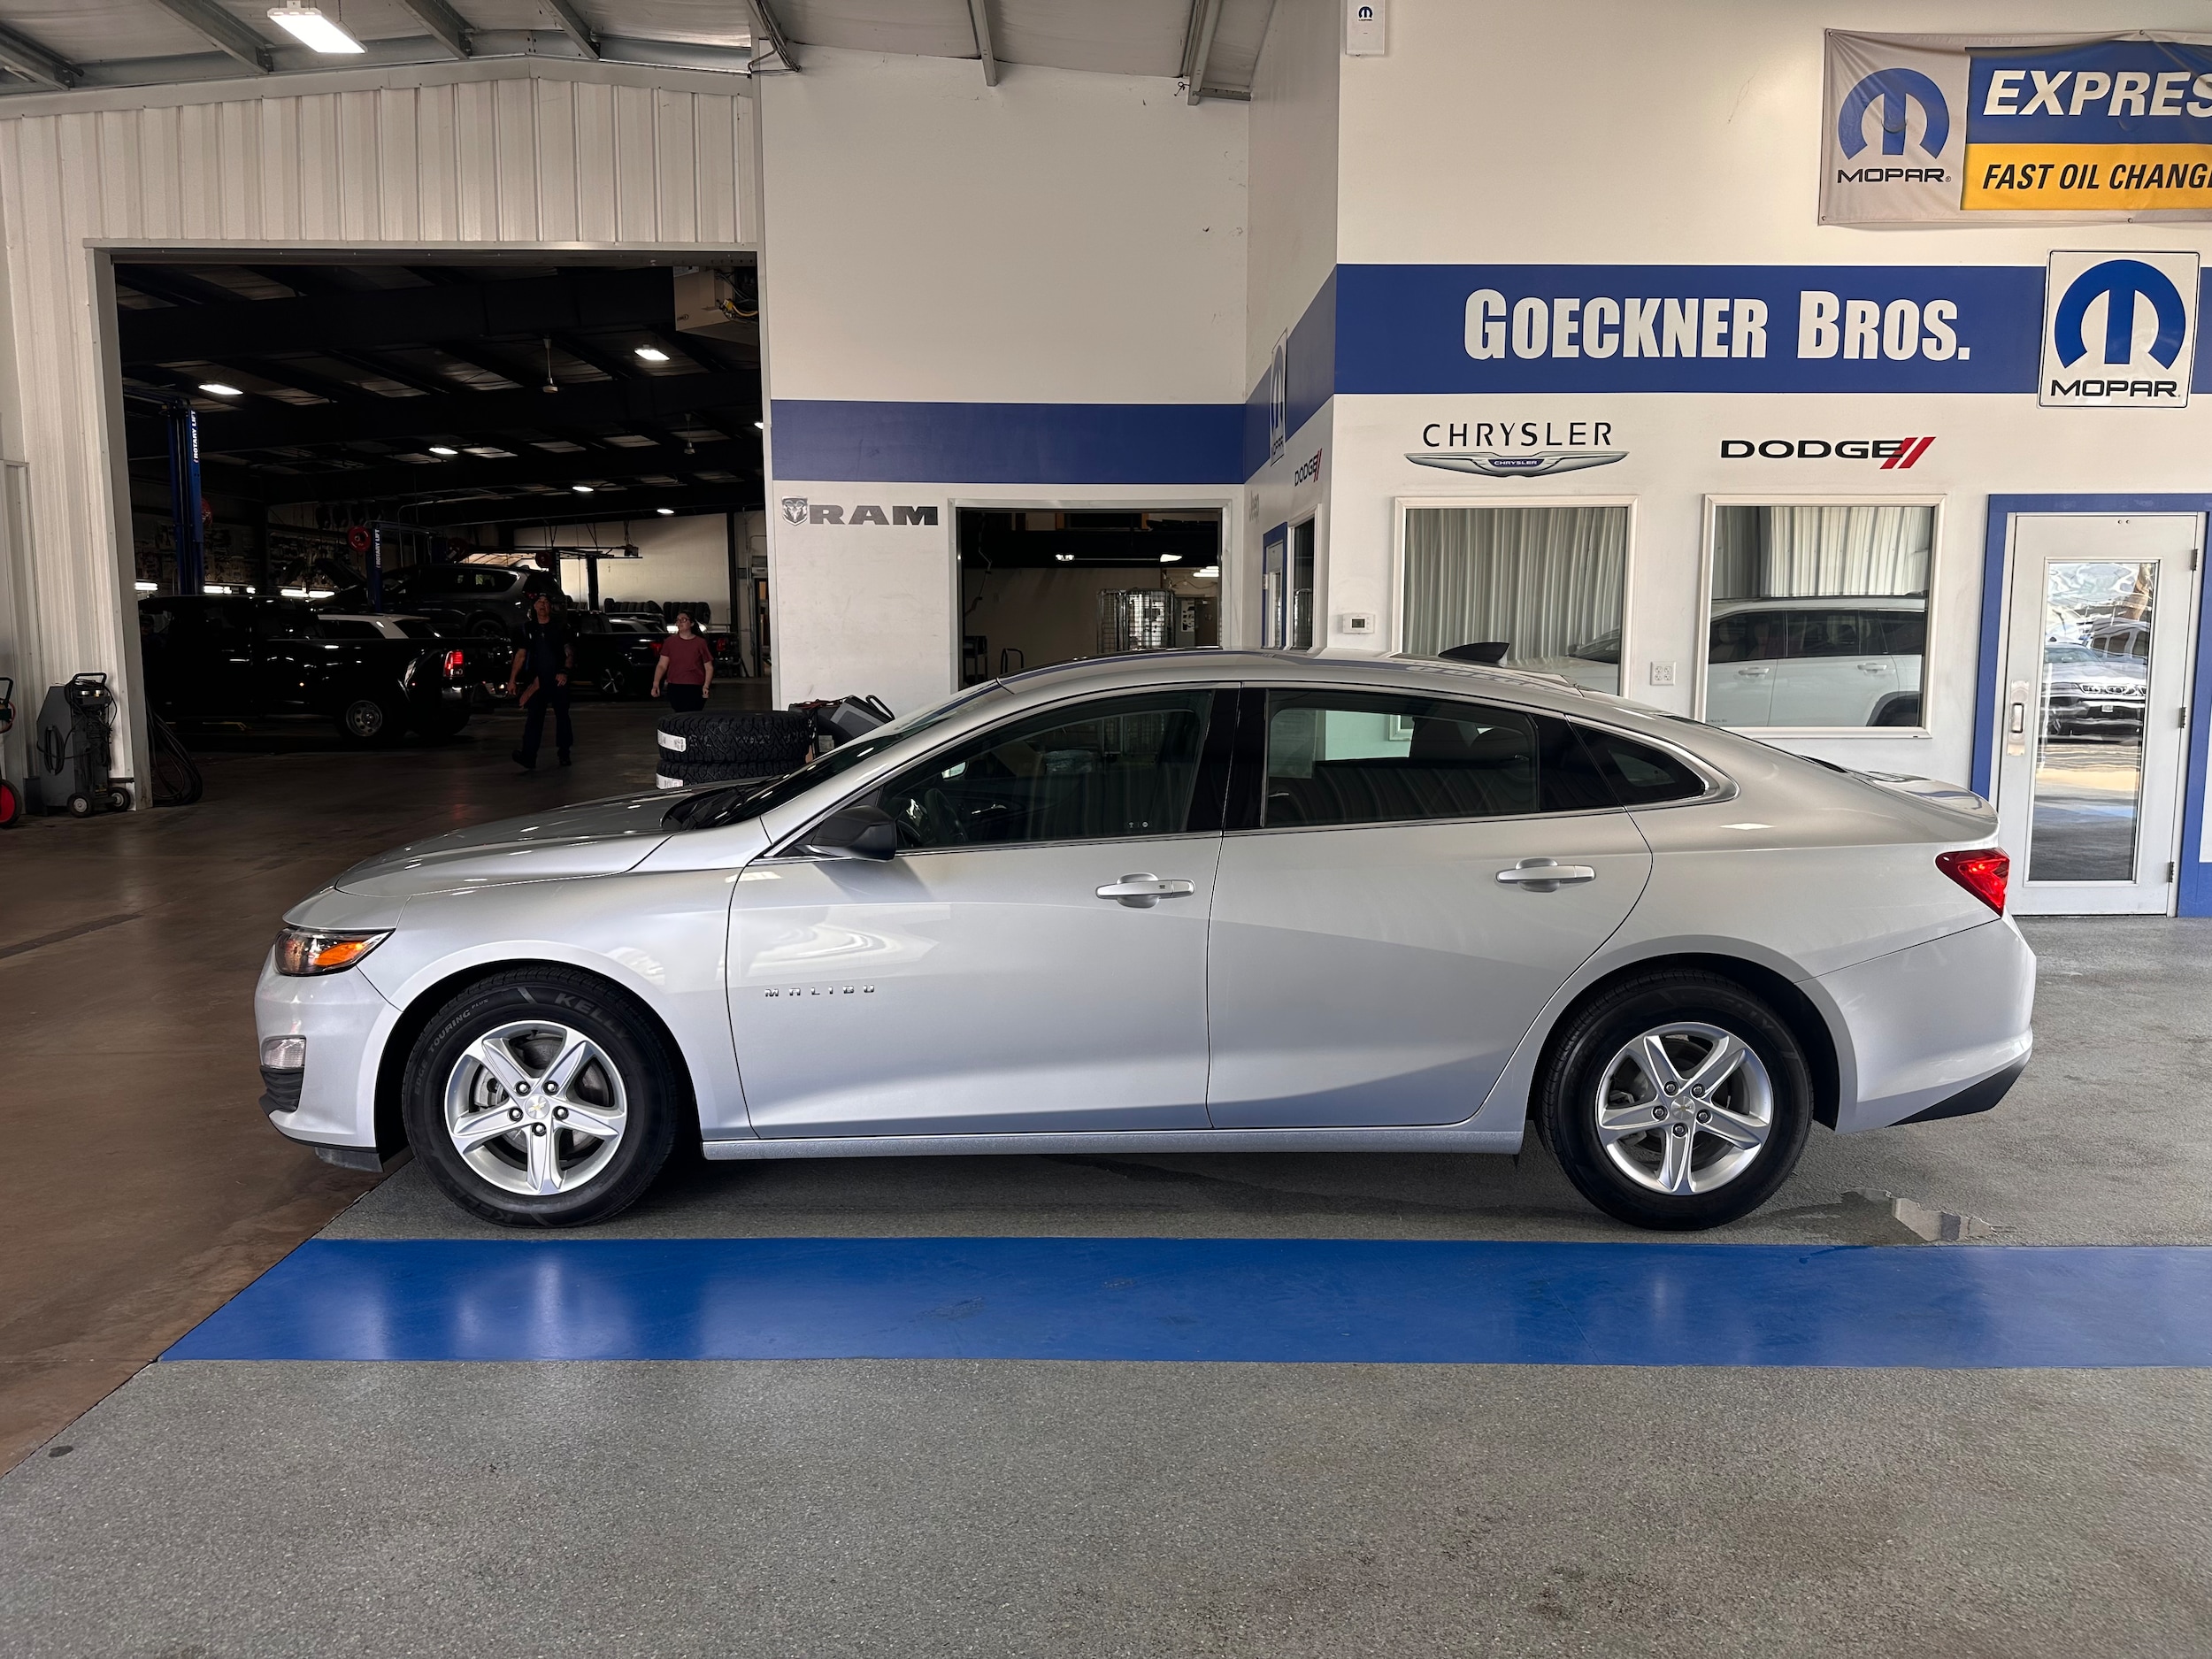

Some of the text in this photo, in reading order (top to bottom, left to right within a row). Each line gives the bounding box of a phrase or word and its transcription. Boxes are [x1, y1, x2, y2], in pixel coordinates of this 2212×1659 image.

[1983, 164, 2212, 189] FAST OIL CHANG
[1464, 288, 1970, 360] GOECKNER BROS.
[2050, 380, 2177, 396] MOPAR
[1423, 422, 1612, 447] CHRYSLER
[1721, 440, 1904, 458] DODGE
[1294, 452, 1318, 487] DODGE
[809, 504, 939, 526] RAM
[764, 984, 874, 997] MALIBU
[555, 992, 632, 1040] KELLY
[414, 998, 489, 1095] EDGE TOURING PLUS
